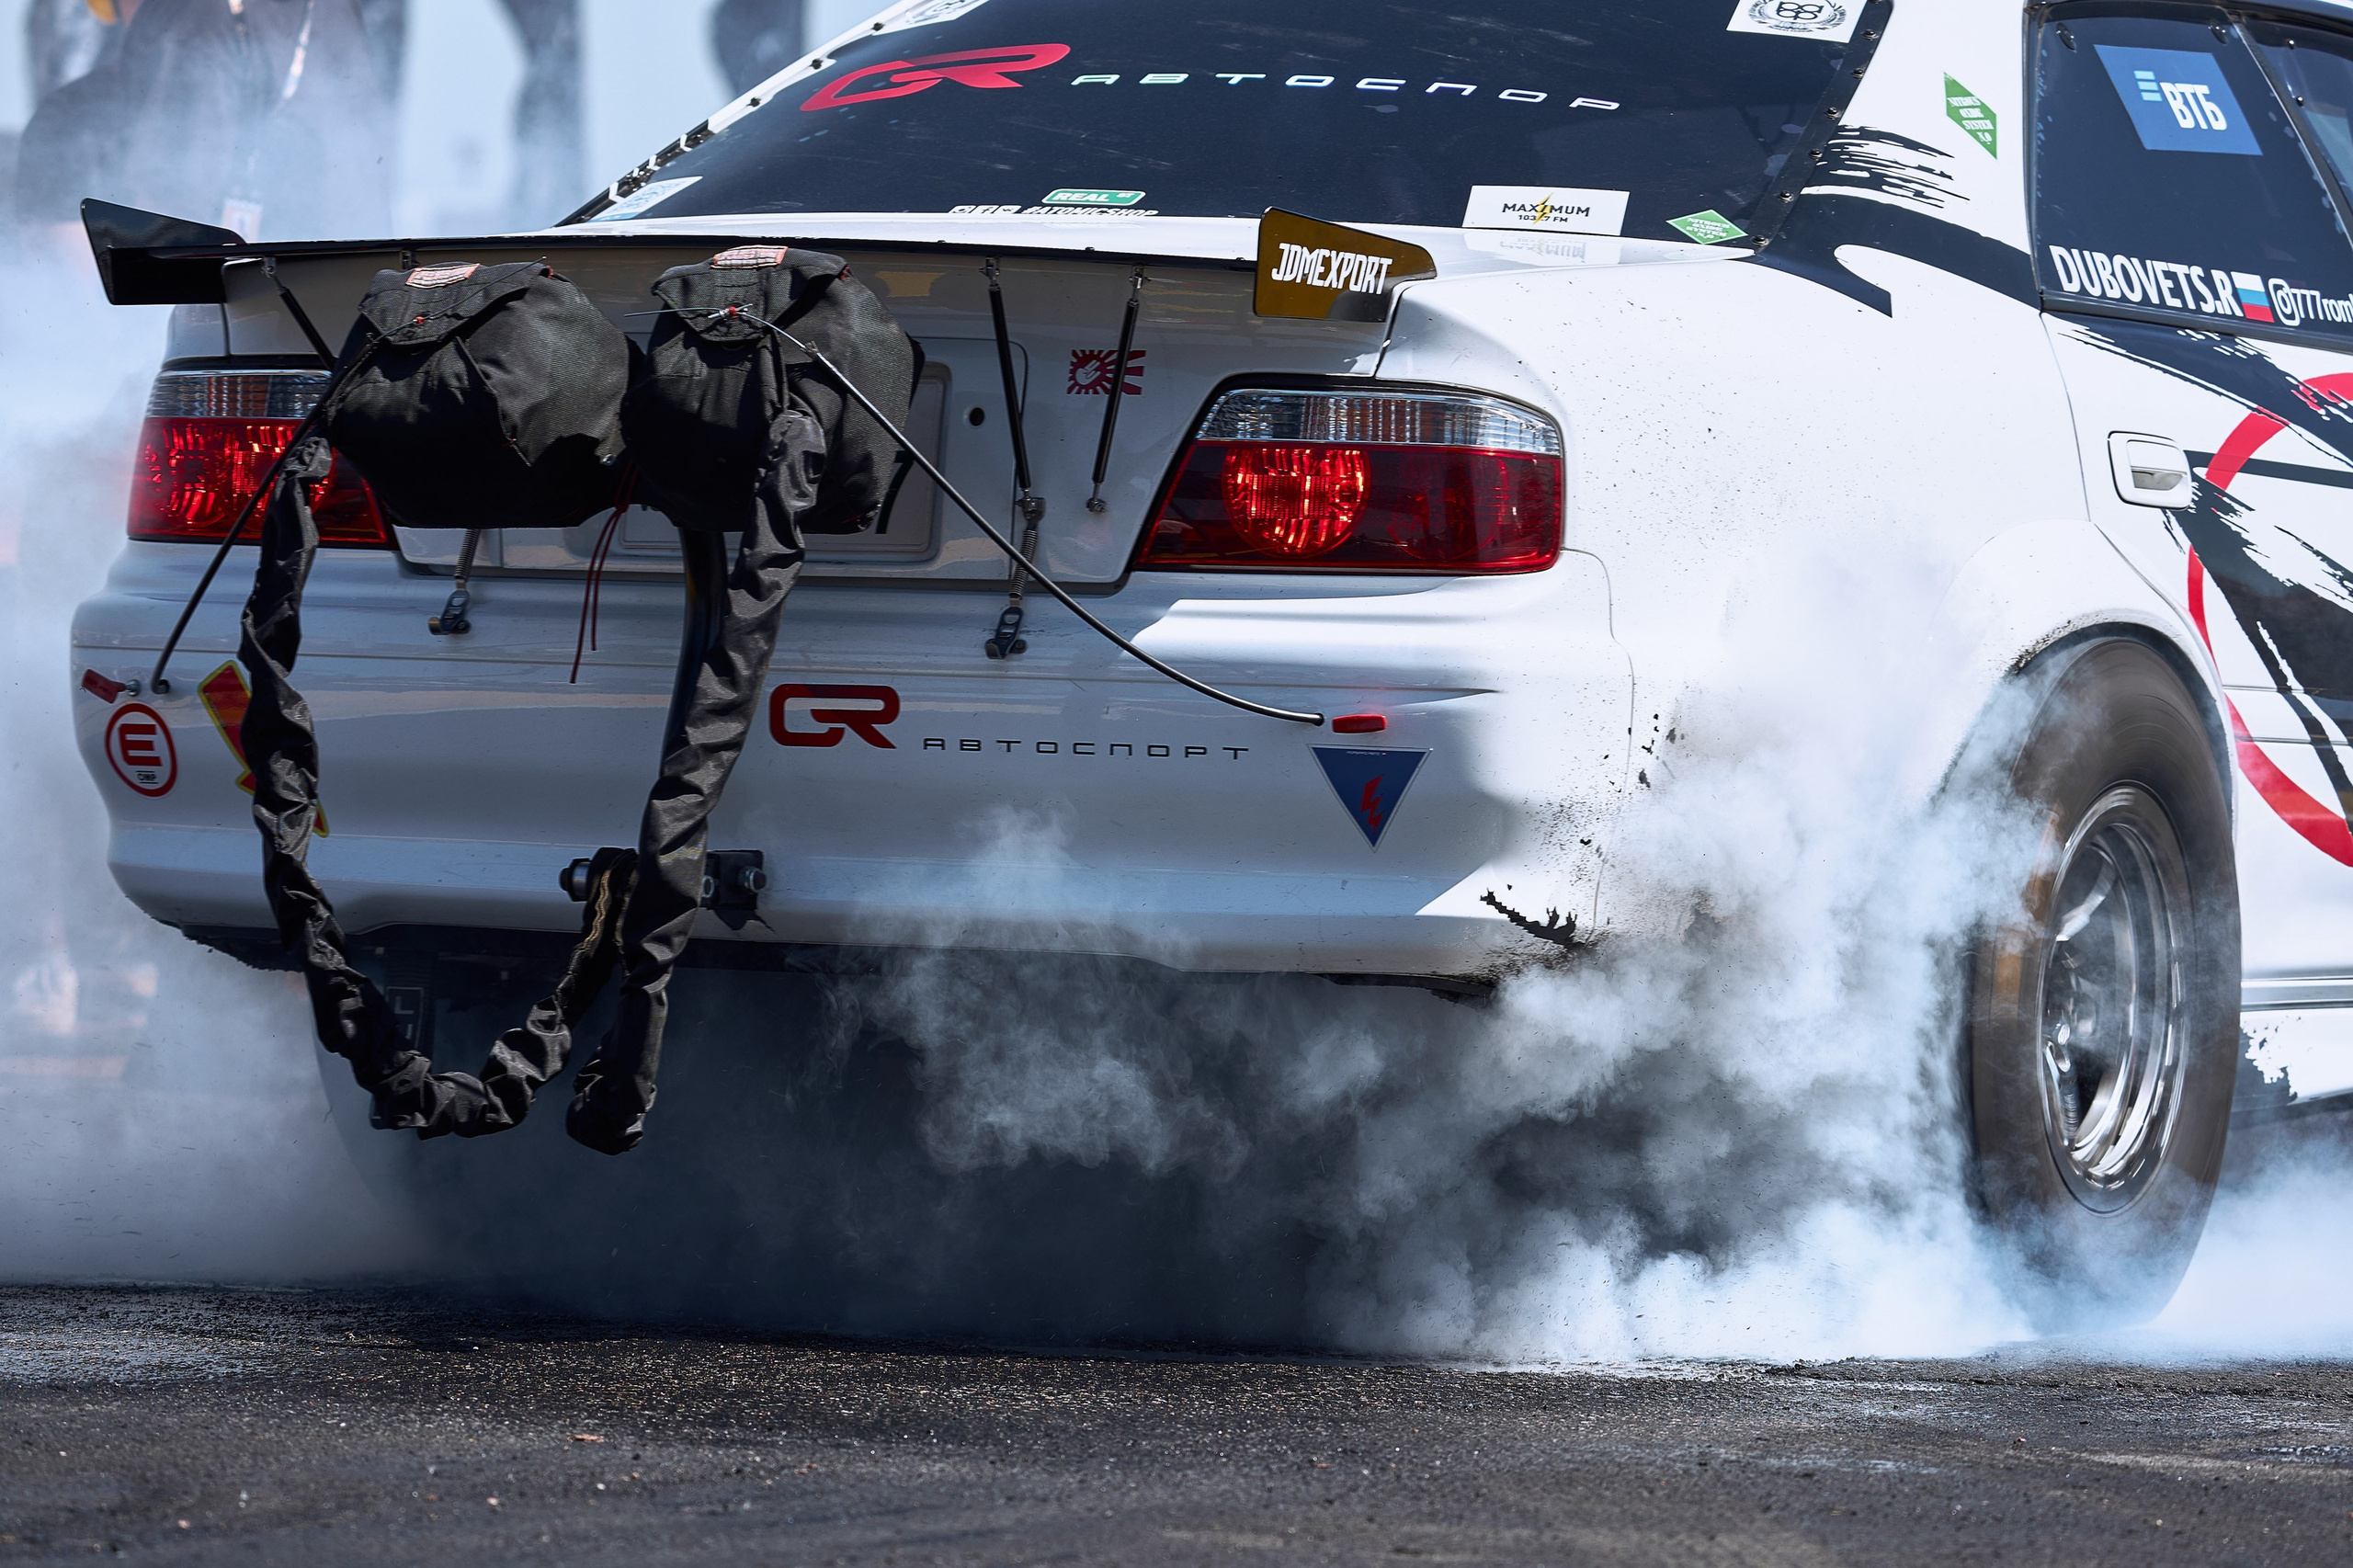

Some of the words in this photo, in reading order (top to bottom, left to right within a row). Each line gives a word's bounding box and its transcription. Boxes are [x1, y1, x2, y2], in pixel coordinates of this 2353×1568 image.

[2159, 82, 2227, 131] ВТБ
[1052, 191, 1110, 202] REAL
[1502, 203, 1591, 217] MAXIMUM
[1271, 243, 1393, 295] JDMEXPORT
[2049, 244, 2244, 317] DUBOVETS.R
[2290, 288, 2353, 323] 777rom
[118, 723, 163, 767] E
[923, 737, 1250, 760] АВТОСПОРТ
